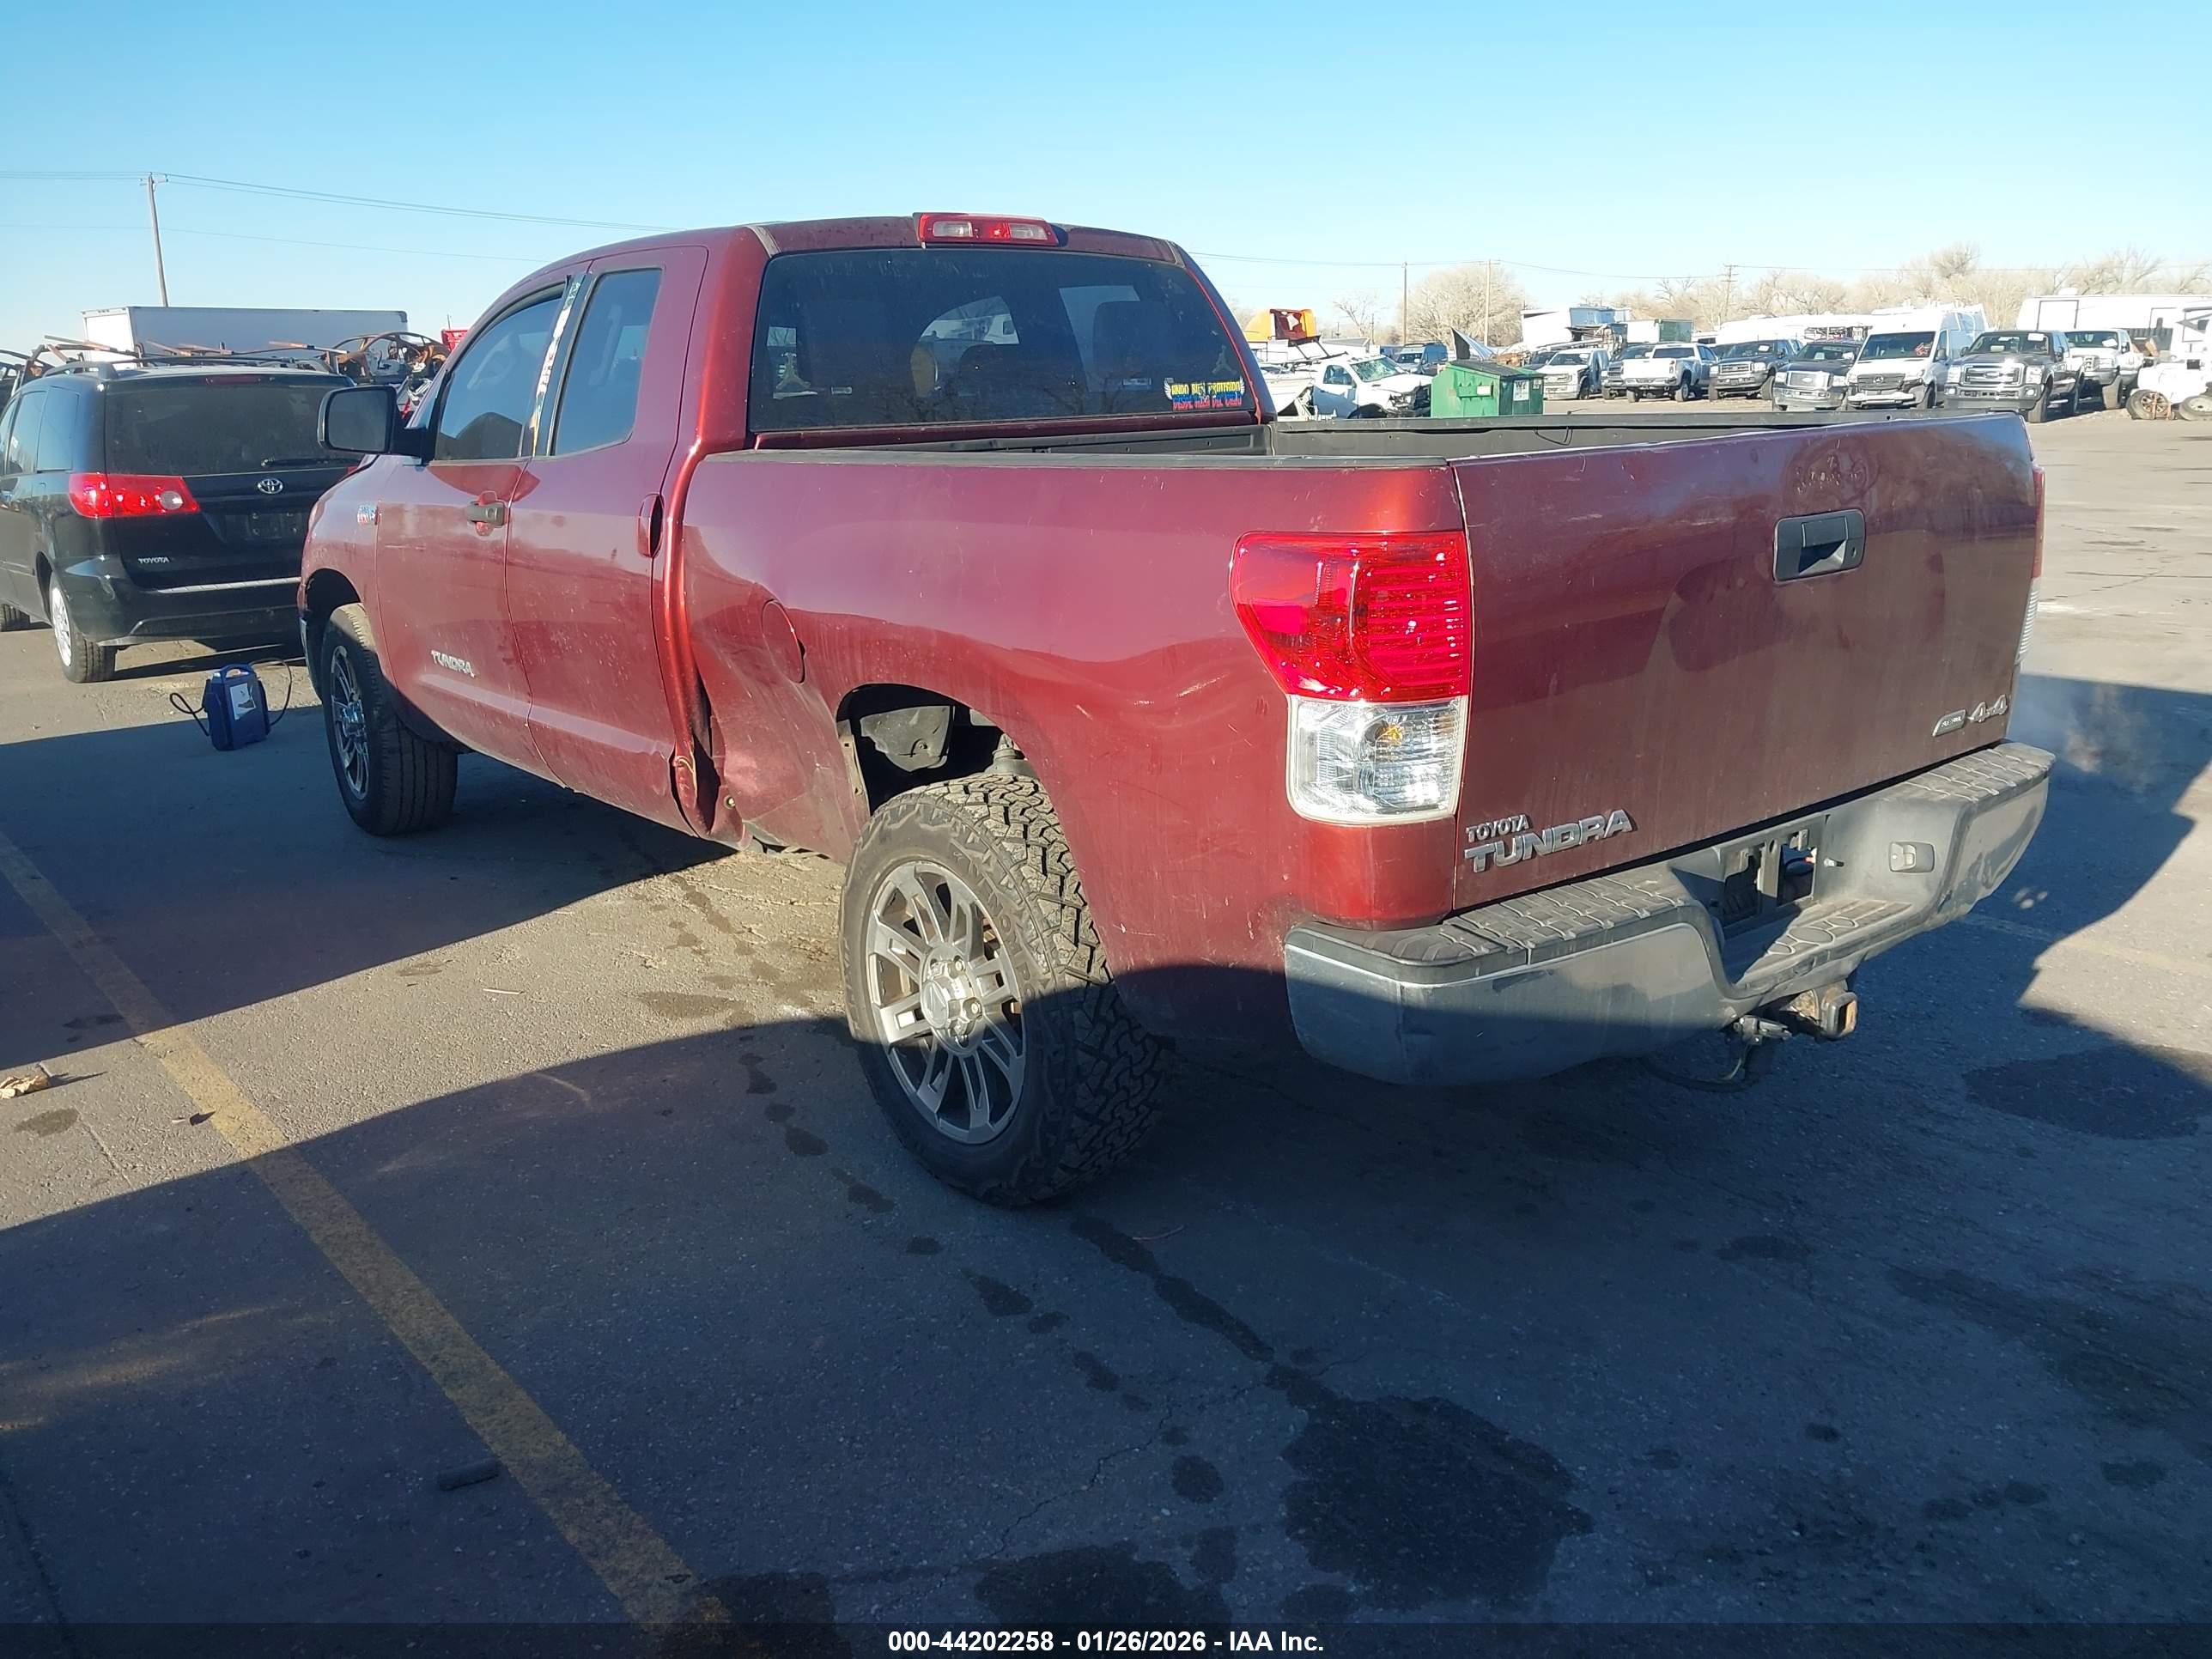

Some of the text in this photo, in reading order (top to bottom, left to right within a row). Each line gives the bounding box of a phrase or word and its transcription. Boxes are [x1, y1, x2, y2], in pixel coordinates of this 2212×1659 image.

[430, 649, 475, 678] TUNDRA
[1464, 809, 1634, 873] TUNDRA
[1466, 814, 1531, 842] TOYOTA
